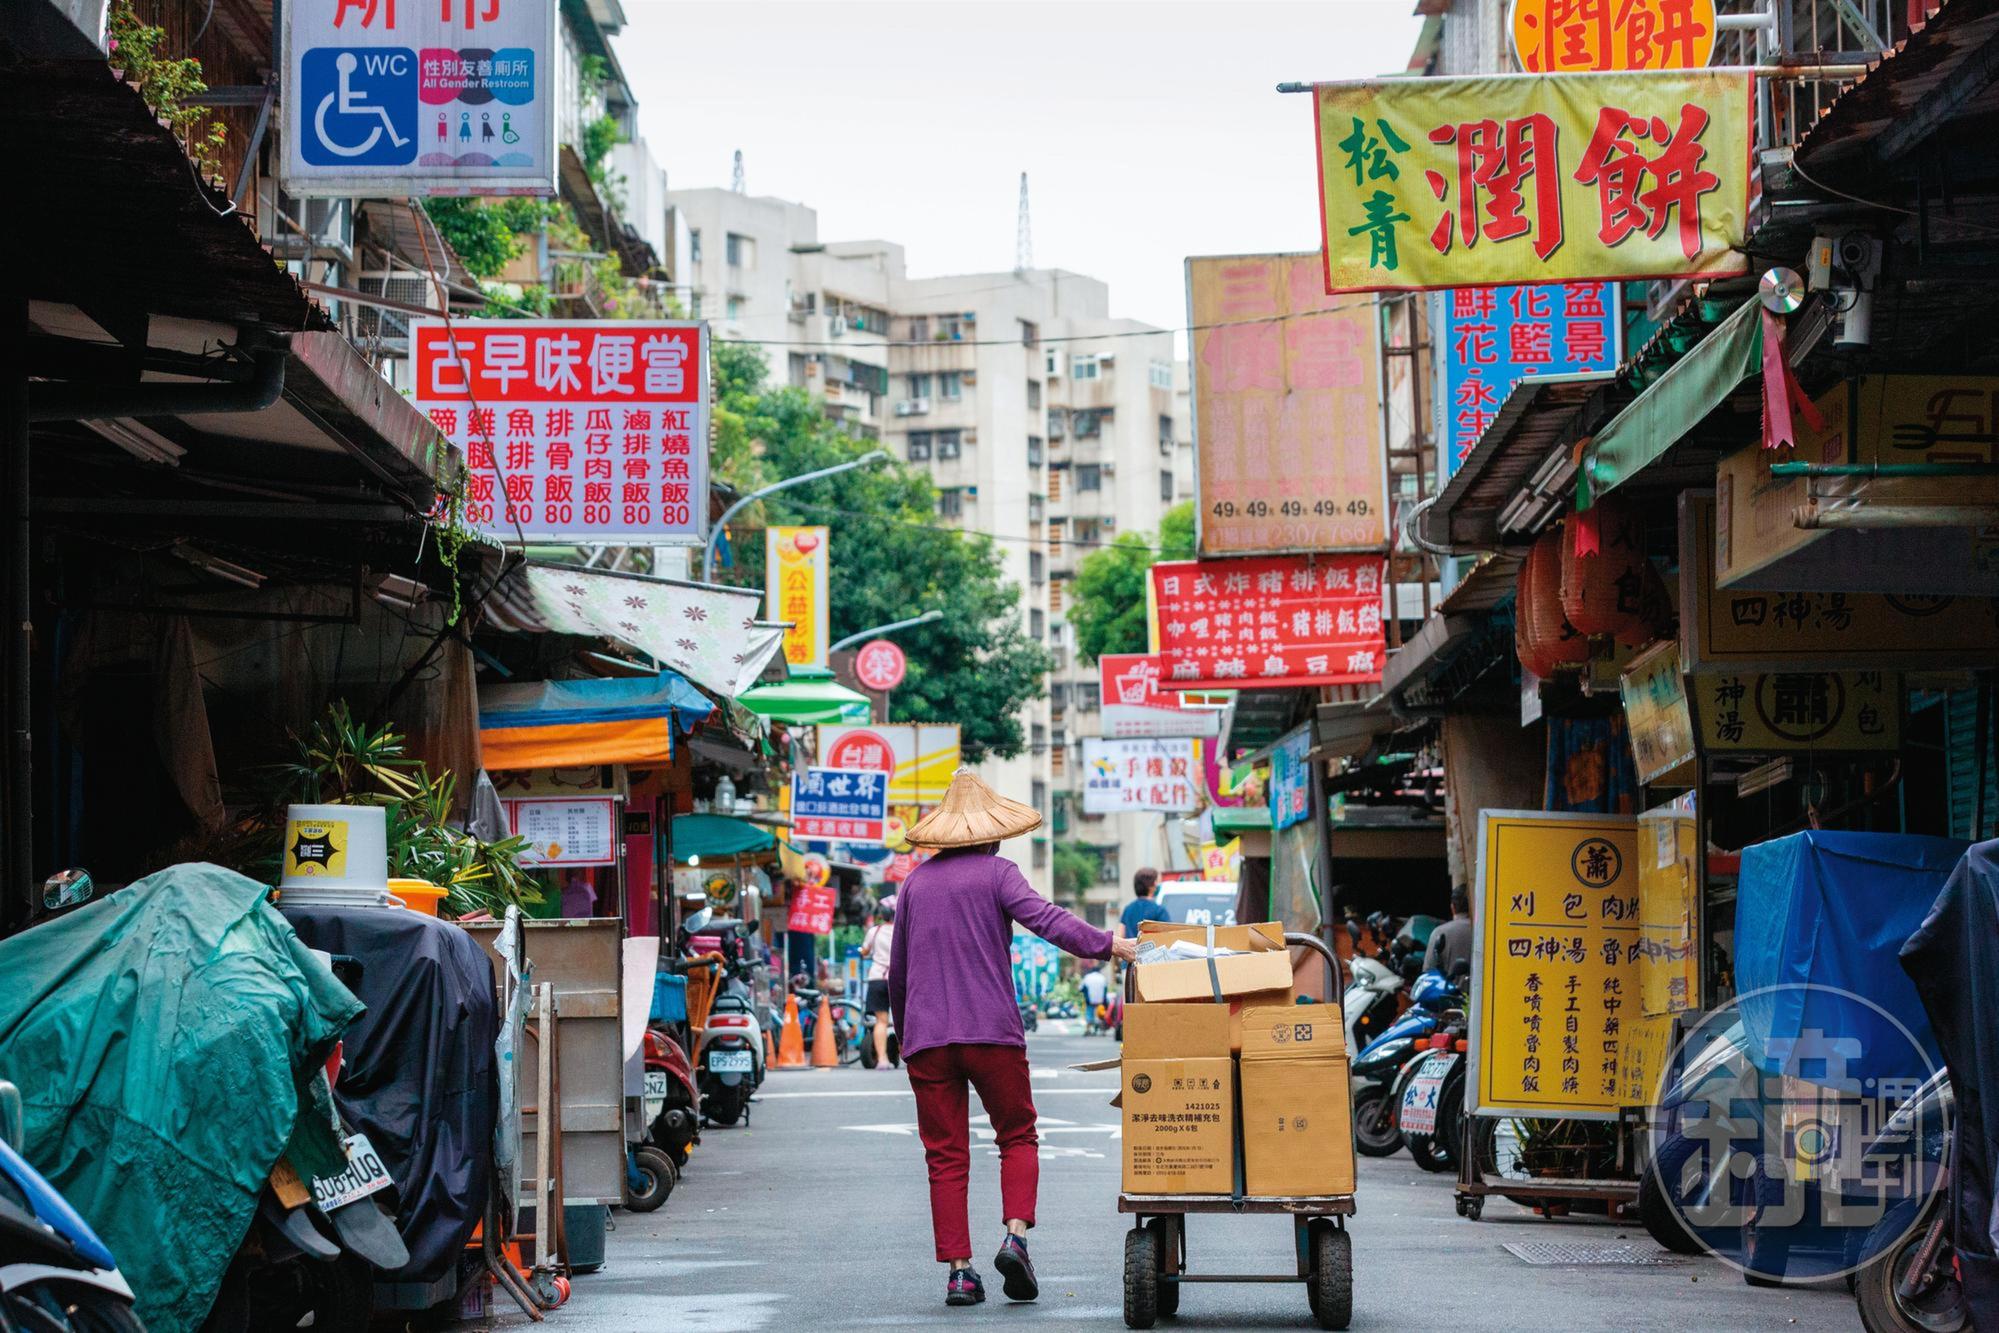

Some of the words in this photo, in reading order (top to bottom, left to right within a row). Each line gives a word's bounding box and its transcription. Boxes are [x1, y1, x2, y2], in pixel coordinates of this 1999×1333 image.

[364, 55, 408, 77] WC
[423, 59, 529, 78] 性別友善廁所
[423, 79, 437, 89] All
[440, 79, 479, 89] Gender
[481, 79, 529, 89] Restroom
[1338, 116, 1412, 272] 松青
[1425, 103, 1720, 262] 潤餅
[428, 333, 689, 396] 古早味便當
[467, 408, 496, 503] 雞腿飯
[505, 408, 535, 503] 魚排飯
[545, 408, 574, 503] 排骨飯
[584, 408, 613, 504] 瓜仔肉飯
[622, 408, 651, 504] 滷排骨飯
[661, 408, 690, 504] 紅燒魚飯
[466, 504, 494, 524] 80
[505, 504, 532, 525] 80
[545, 504, 573, 525] 80
[584, 504, 611, 525] 80
[623, 504, 650, 525] 80
[663, 504, 690, 525] 80
[1167, 618, 1210, 639] 咖哩
[1731, 594, 1854, 633] 四神湯
[1214, 627, 1279, 642] 牛肉飯
[1510, 890, 1587, 919] 刈包
[1508, 936, 1587, 964] 四神湯
[1521, 972, 1544, 1093] 香噴噴魯肉飯
[1131, 1113, 1221, 1123] 潔淨去味洗衣精補充包
[1155, 1125, 1178, 1133] 2000g
